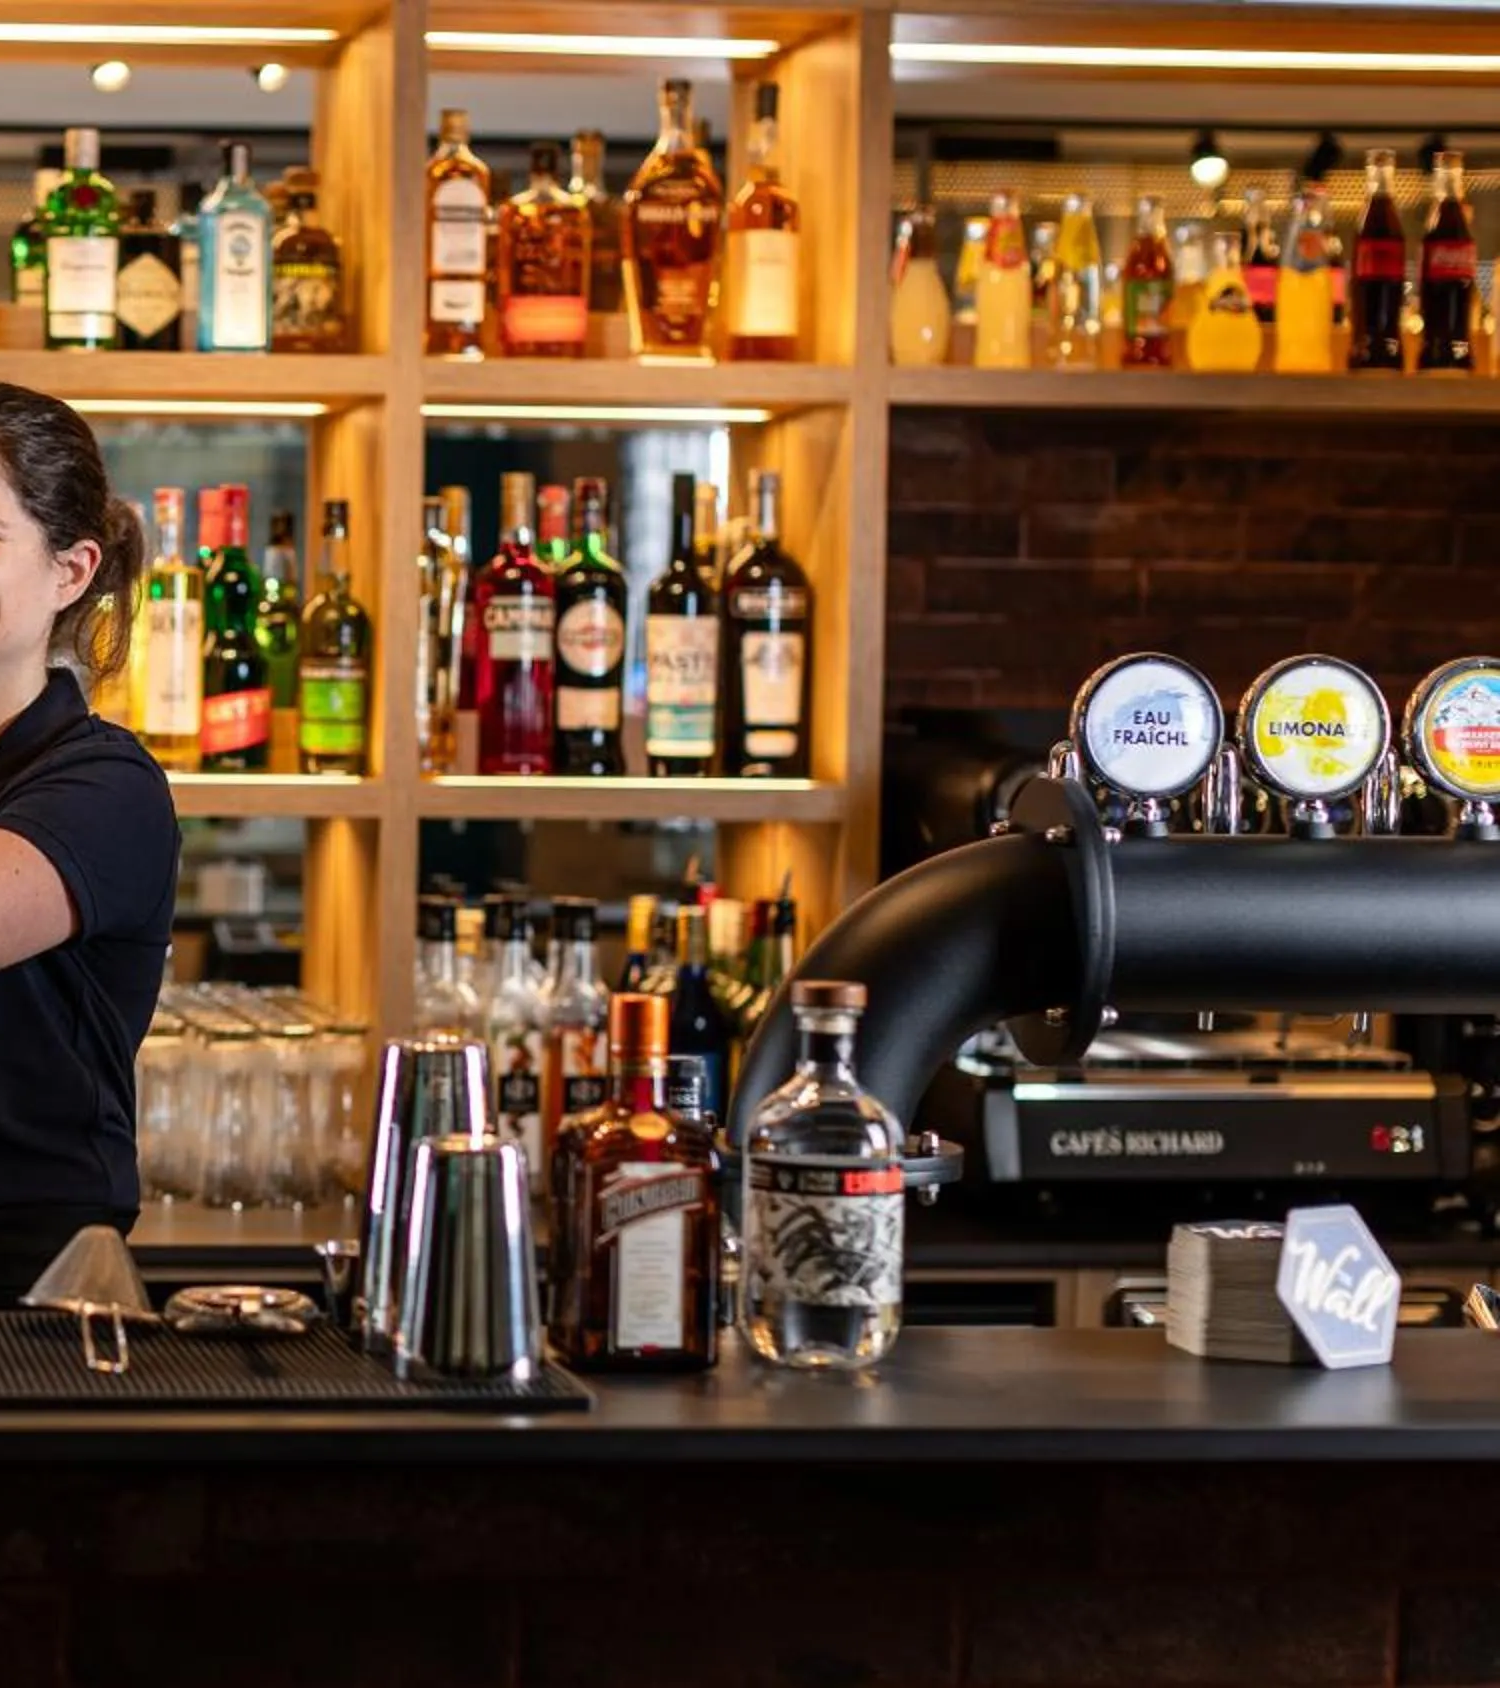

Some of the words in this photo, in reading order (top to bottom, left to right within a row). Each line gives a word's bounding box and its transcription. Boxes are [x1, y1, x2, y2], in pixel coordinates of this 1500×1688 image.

[1133, 710, 1171, 726] EAU
[1269, 720, 1369, 738] LIMONA
[1125, 1130, 1224, 1156] RICHARD
[1289, 1237, 1395, 1332] Wall
